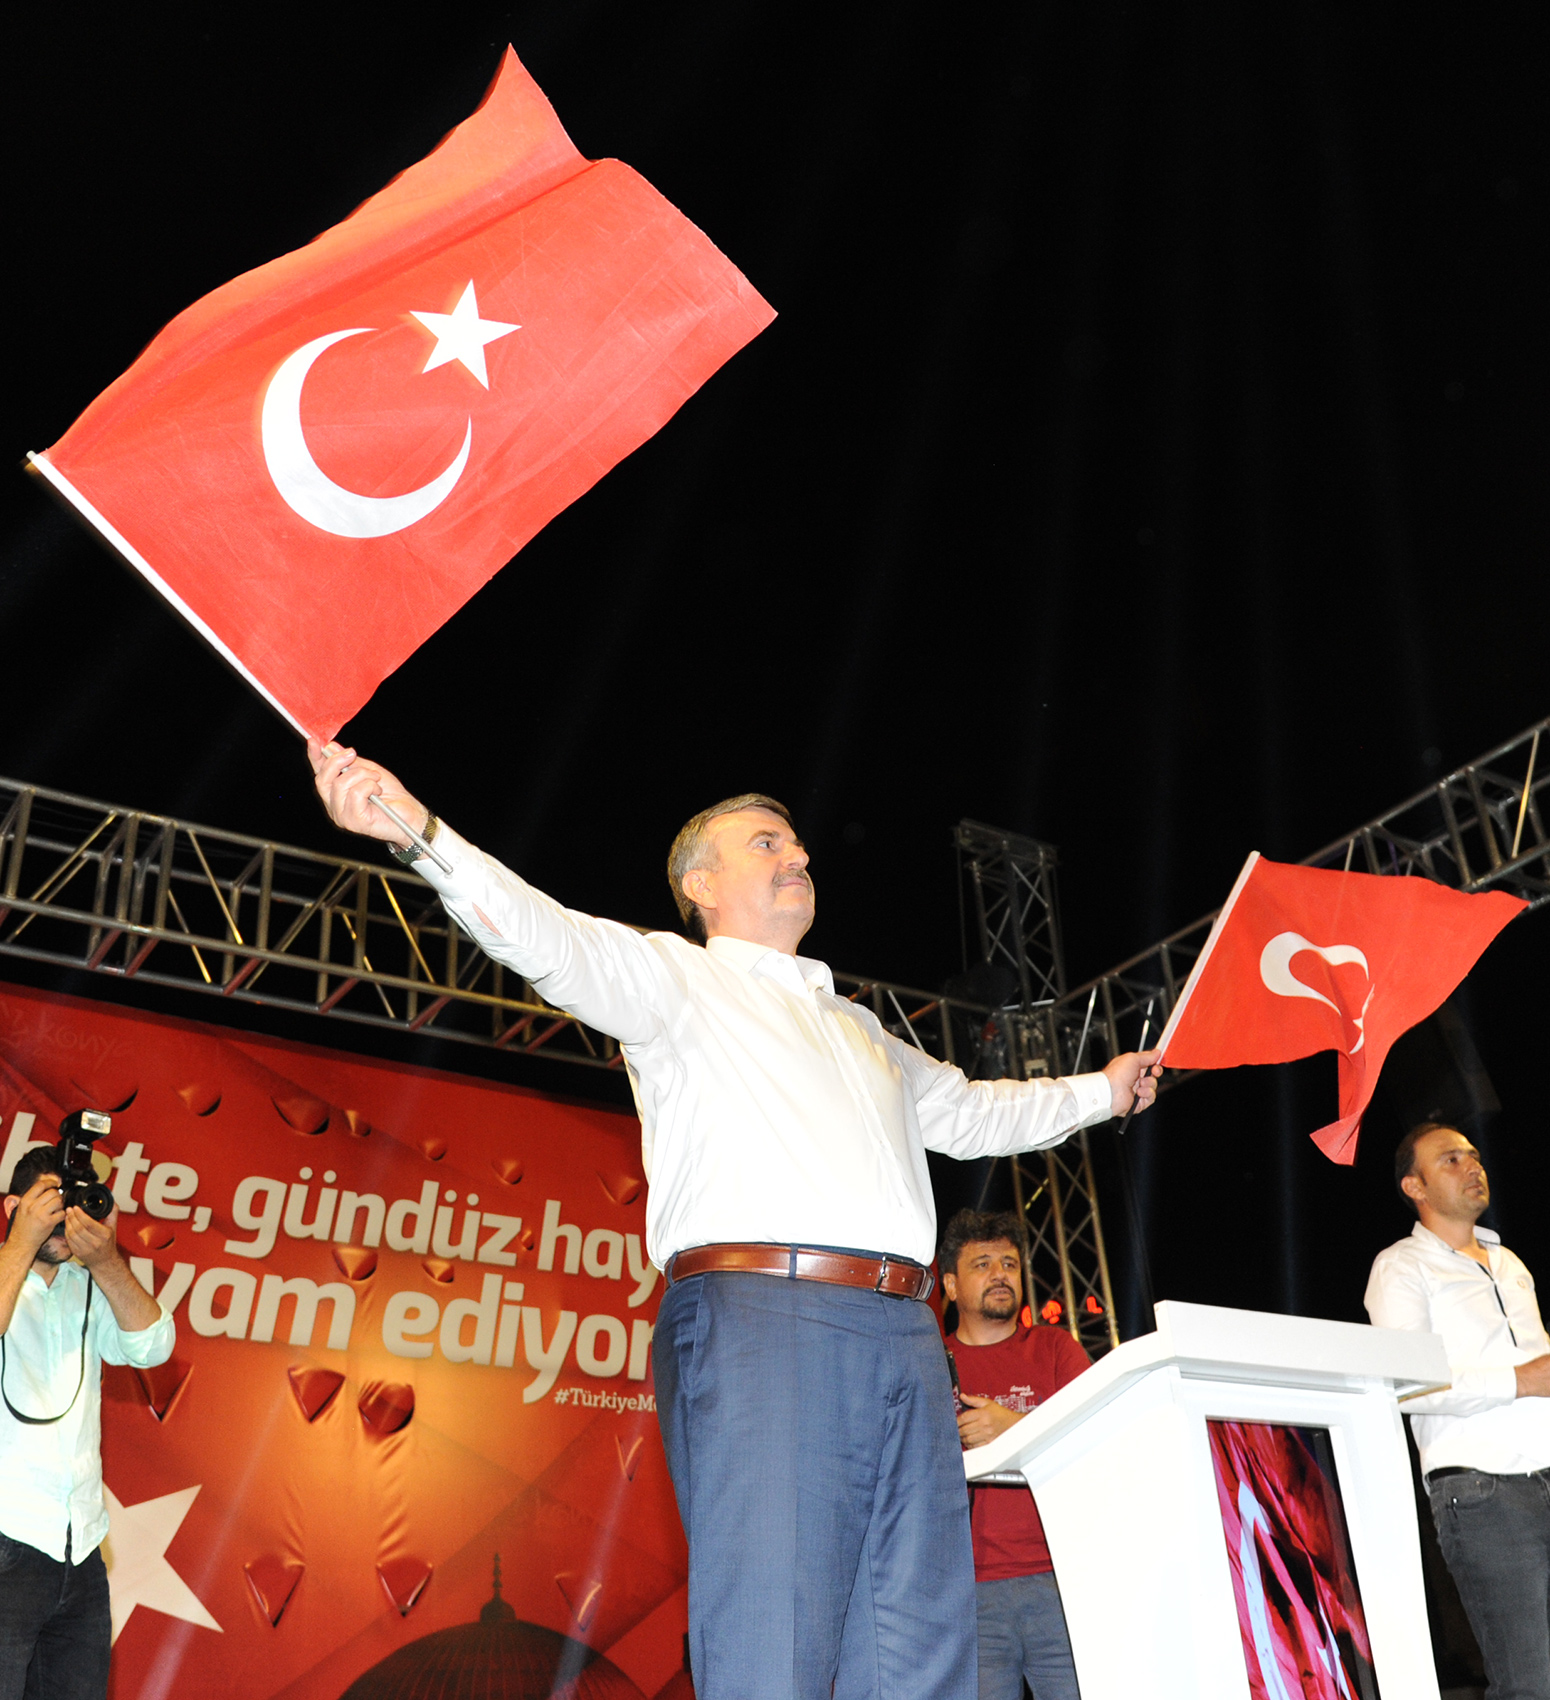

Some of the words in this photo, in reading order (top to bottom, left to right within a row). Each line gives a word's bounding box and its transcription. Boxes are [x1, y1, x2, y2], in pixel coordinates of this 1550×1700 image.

[224, 1166, 522, 1266] gündüz
[130, 1256, 356, 1350] vam
[554, 1387, 658, 1415] #TürkiyeM
